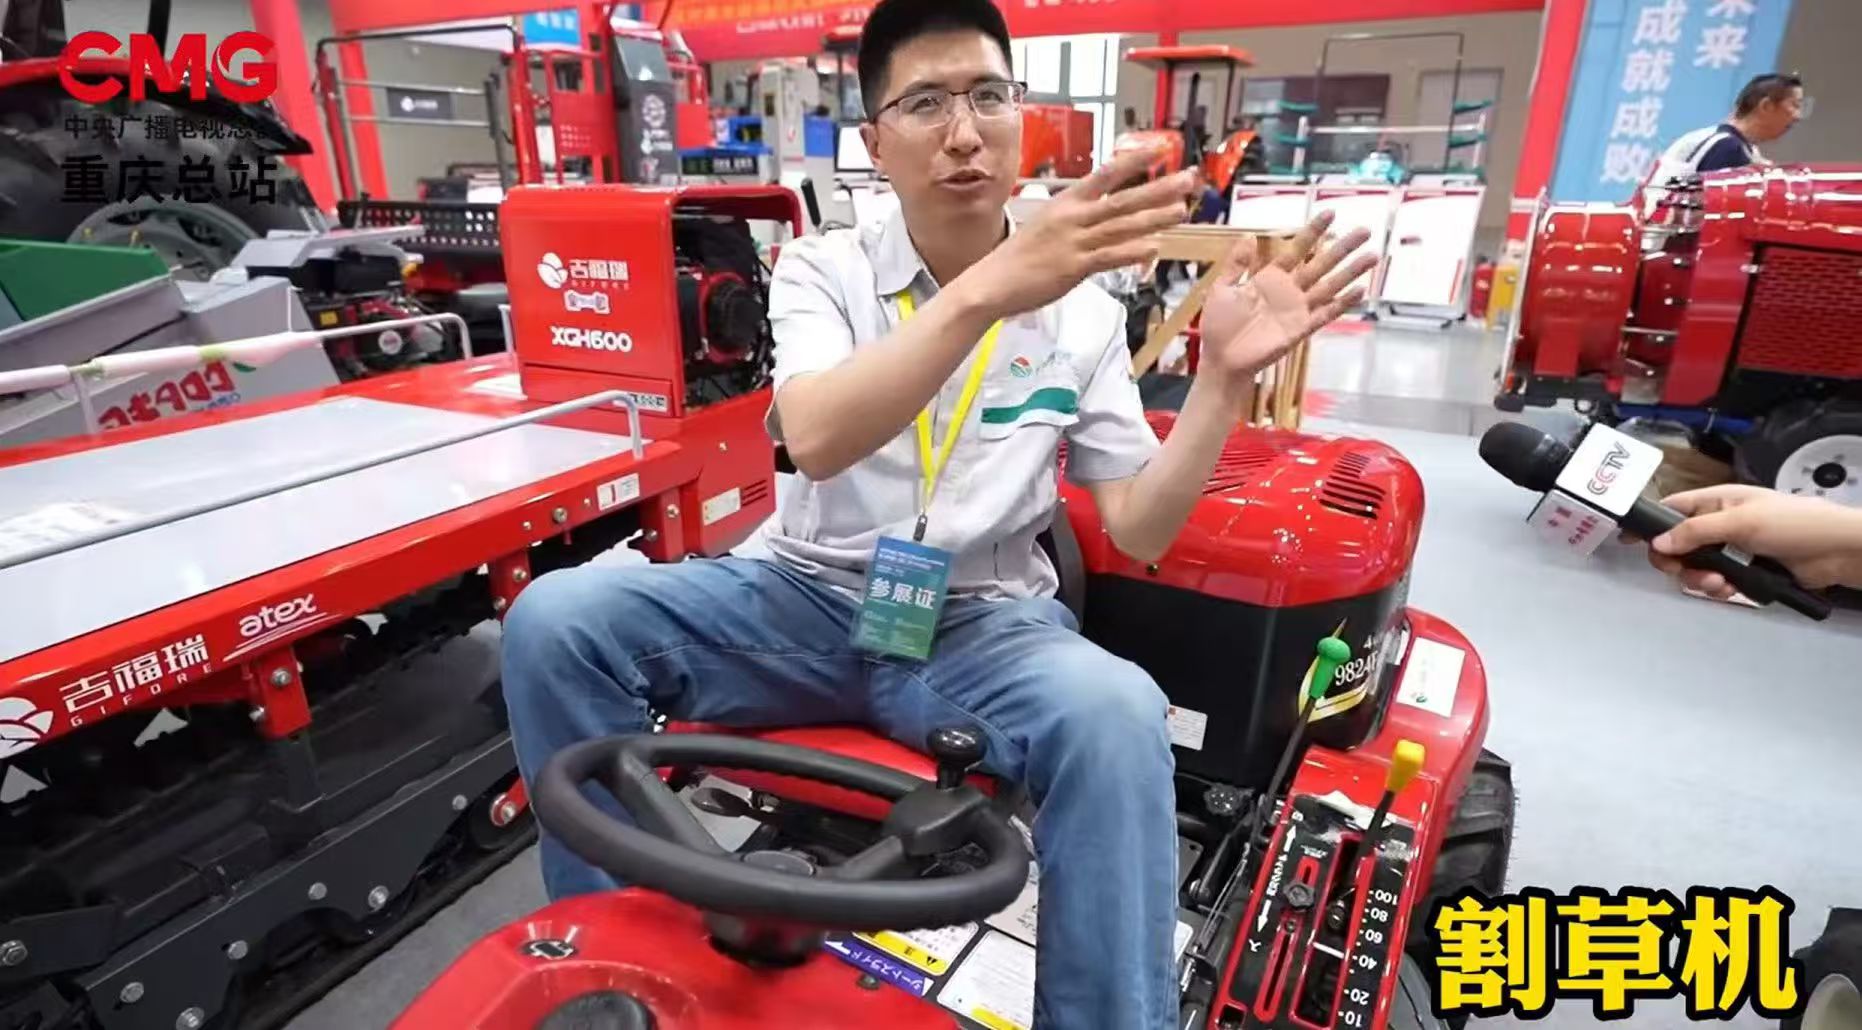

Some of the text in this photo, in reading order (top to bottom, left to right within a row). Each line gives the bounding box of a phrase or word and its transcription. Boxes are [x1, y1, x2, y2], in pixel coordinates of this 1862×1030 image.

[1600, 0, 1688, 183] 成就成败
[550, 325, 633, 353] XGH600
[1586, 440, 1631, 496] CCTV
[869, 576, 937, 610] 参展证
[238, 593, 317, 638] atex
[59, 633, 210, 713] 吉福瑞
[71, 663, 213, 728] GIFORE
[1374, 888, 1398, 906] 100
[1370, 906, 1389, 923] 80
[1364, 928, 1383, 945] 60
[1358, 953, 1378, 971] 40
[1350, 988, 1370, 1006] 20
[1344, 1010, 1363, 1028] 10
